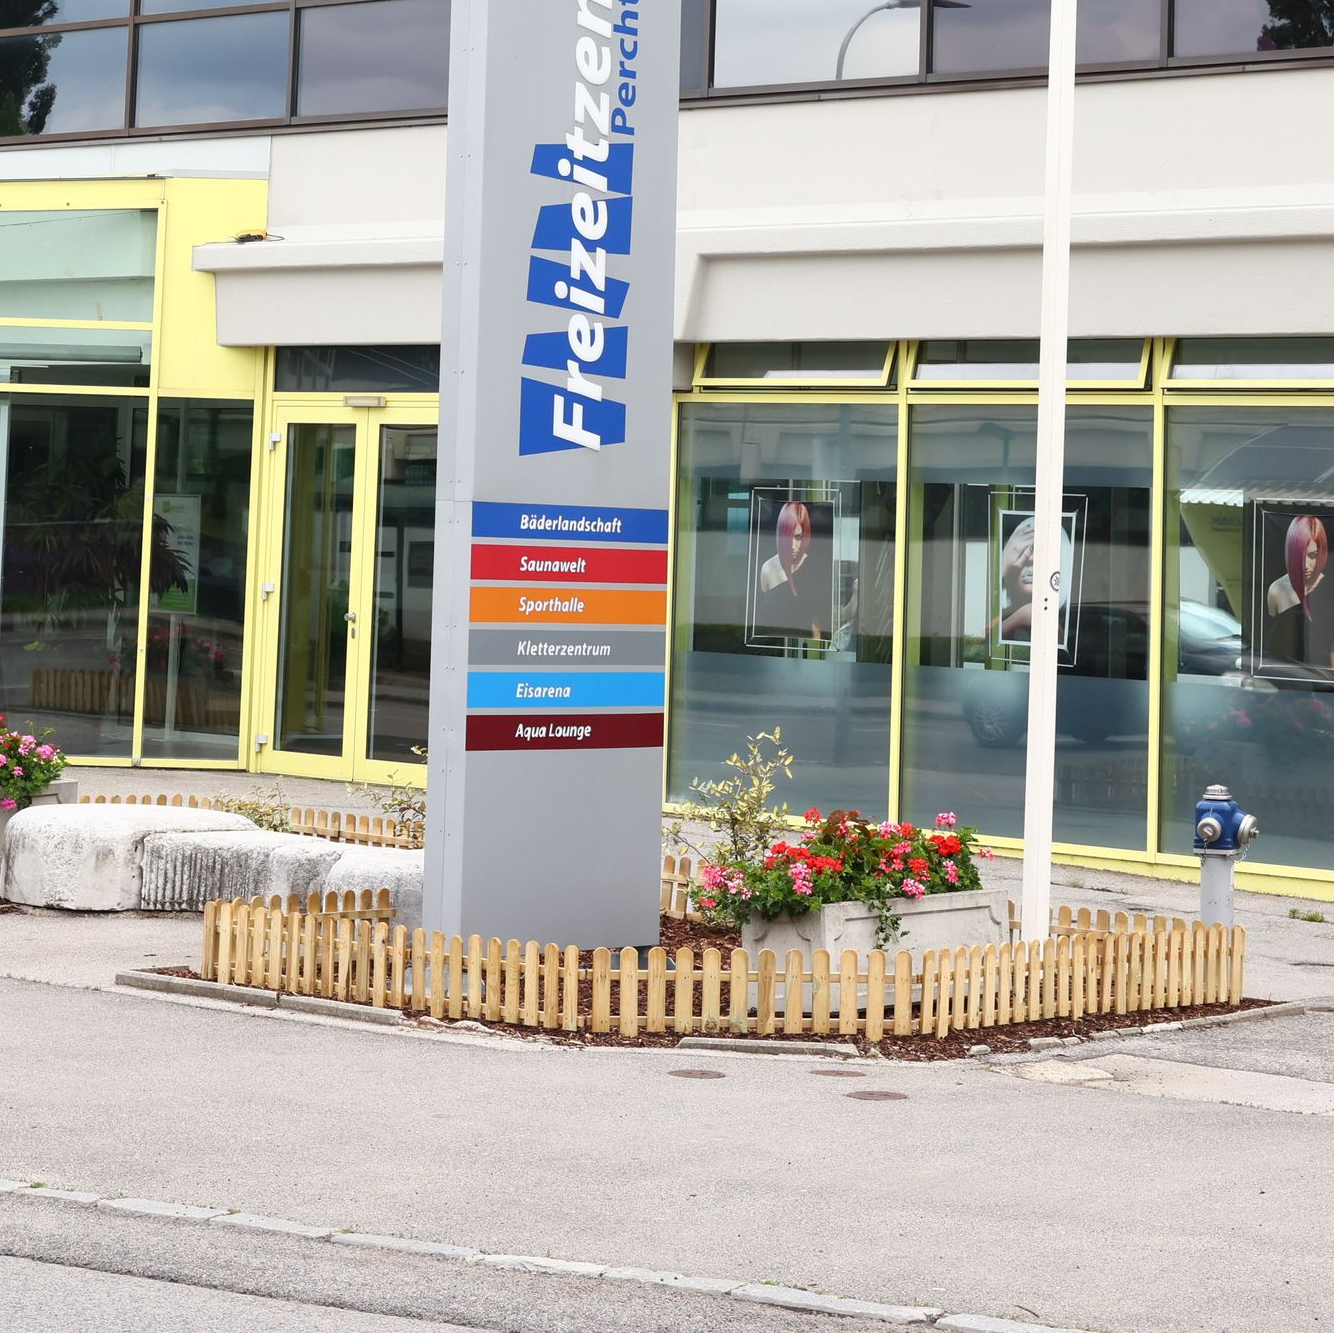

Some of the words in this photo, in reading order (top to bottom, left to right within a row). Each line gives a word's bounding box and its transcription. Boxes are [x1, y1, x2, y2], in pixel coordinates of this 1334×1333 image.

[520, 514, 622, 533] Bäderlandschaft
[519, 556, 586, 573] Saunawelt
[518, 596, 585, 615] Sporthalle
[517, 640, 611, 656] Kletterzentrum
[516, 683, 571, 698] Eisarena
[515, 723, 546, 741] Aqua
[549, 723, 592, 741] Lounge
